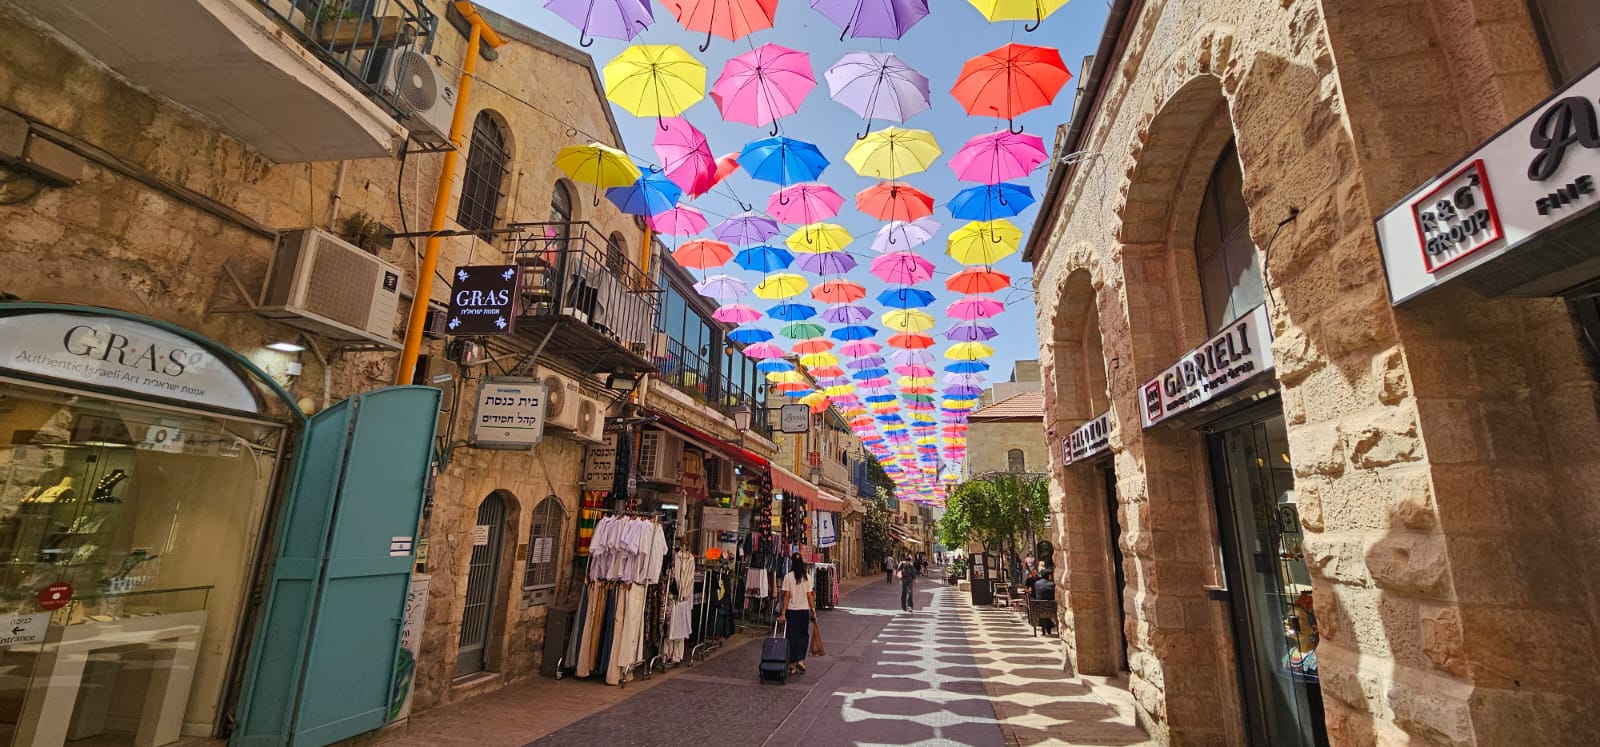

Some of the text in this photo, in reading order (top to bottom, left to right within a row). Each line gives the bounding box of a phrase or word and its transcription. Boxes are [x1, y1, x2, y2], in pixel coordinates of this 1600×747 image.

[1425, 209, 1490, 256] GROUP
[1163, 322, 1252, 398] GABRIELI
[15, 350, 140, 385] Authentic Israeli Art
[142, 377, 180, 392] ישראלית
[484, 396, 539, 407] בית כנסת
[482, 411, 536, 427] קהל חסידים
[590, 448, 616, 457] הכנסת
[593, 458, 611, 471] קהל
[587, 472, 614, 481] חסידים
[0, 635, 36, 644] ntrance
